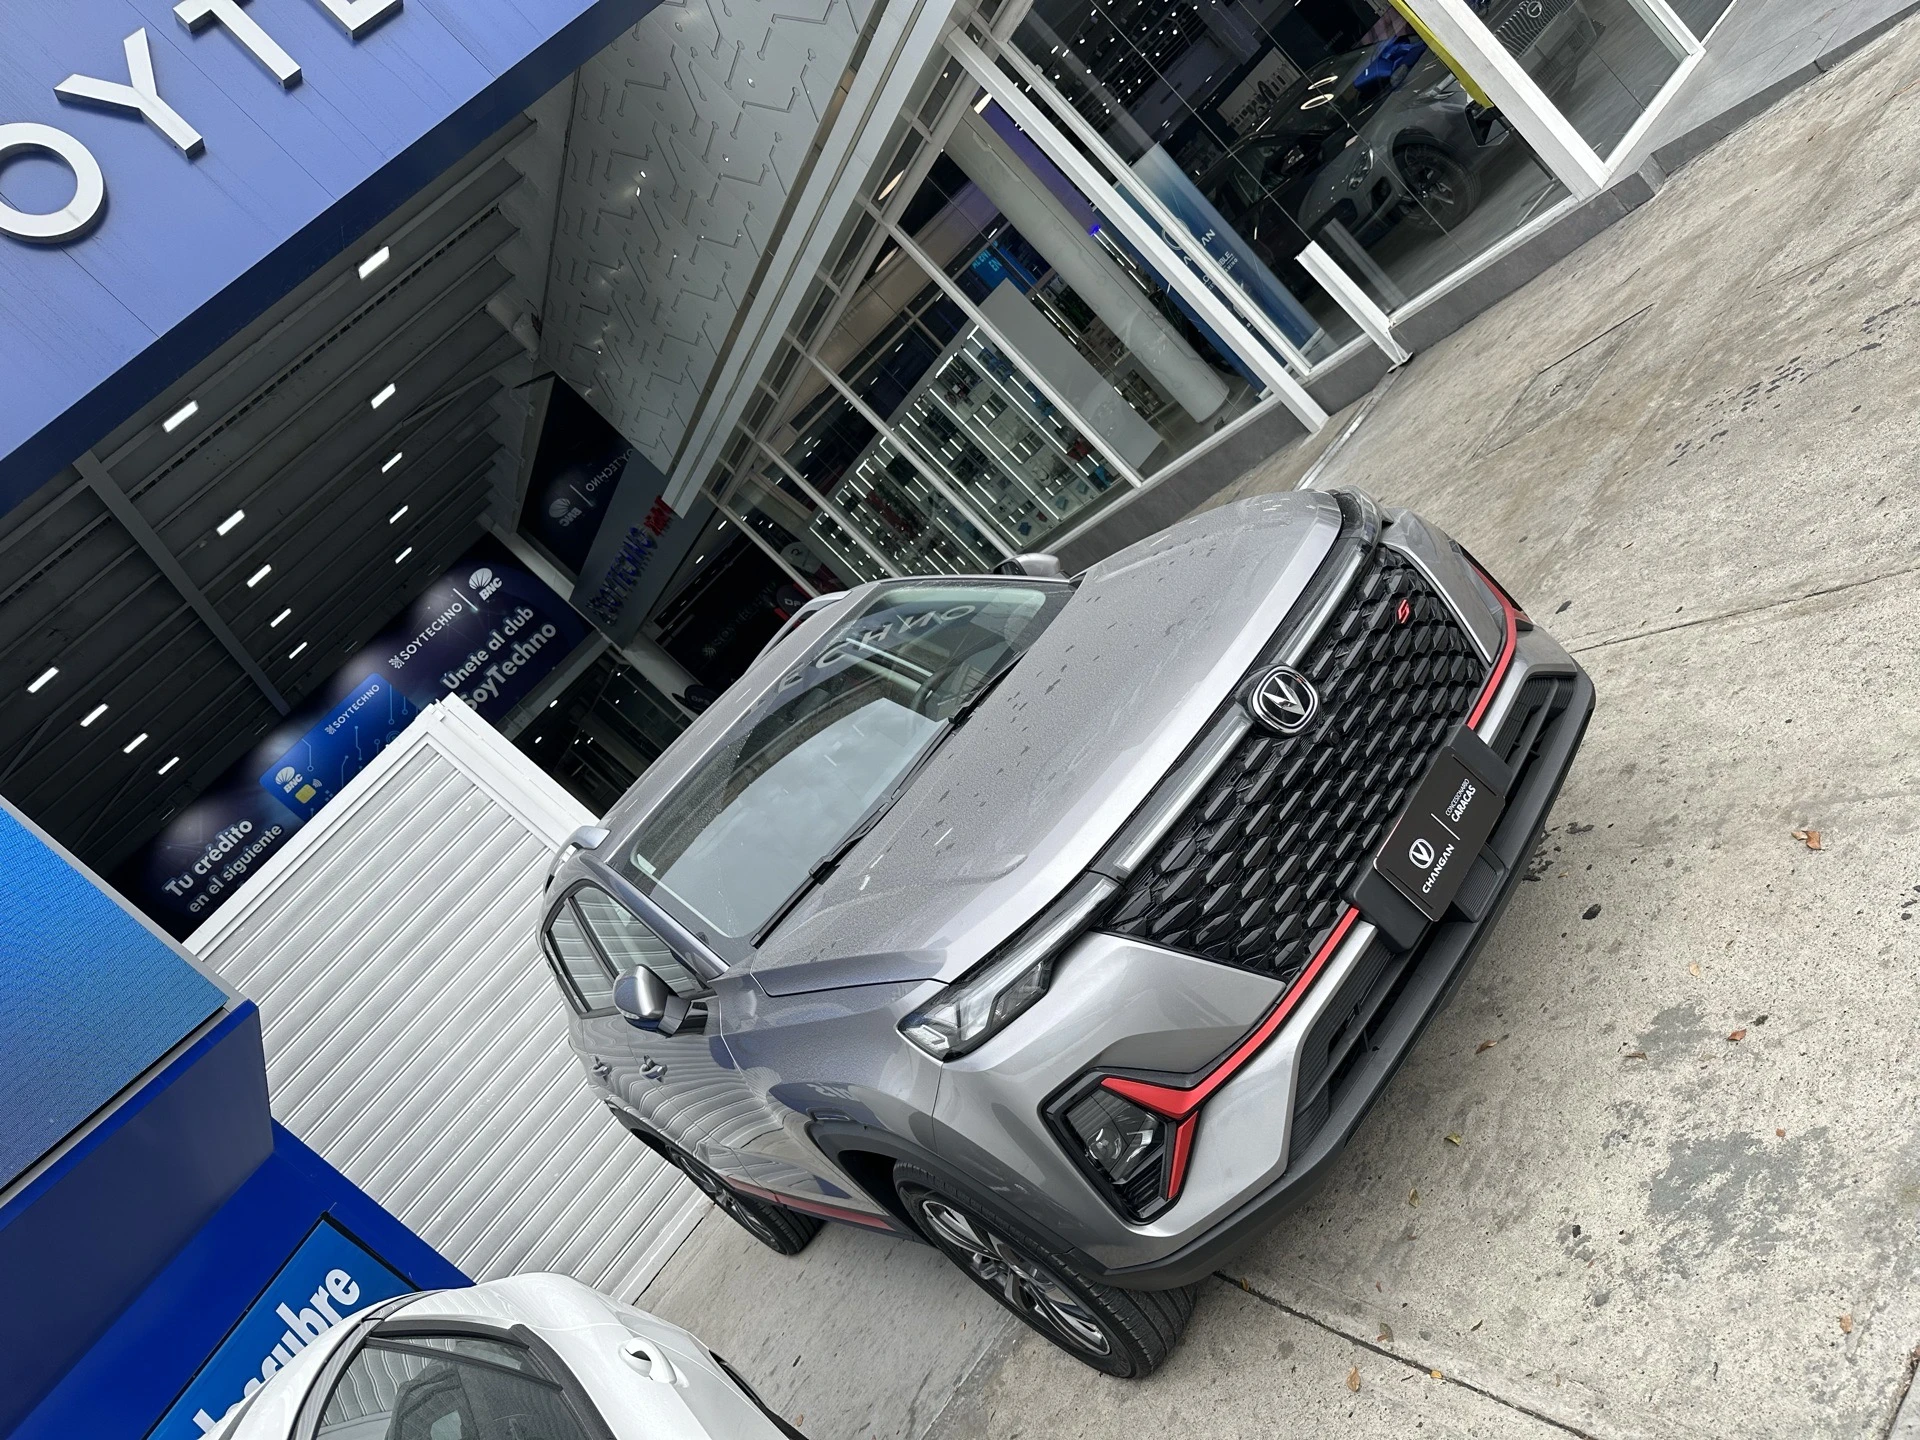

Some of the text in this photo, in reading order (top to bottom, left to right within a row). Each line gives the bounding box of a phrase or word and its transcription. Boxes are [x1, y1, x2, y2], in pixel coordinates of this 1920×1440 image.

[0, 0, 404, 243] OYT
[478, 577, 503, 601] BNC
[400, 602, 463, 661] SOYTECHNO
[442, 608, 534, 690] Únete al club
[332, 684, 380, 729] SOYTECHNO
[283, 773, 303, 794] BNC
[1445, 778, 1470, 816] CONCESIONARIO
[1451, 784, 1476, 823] CARACAS
[165, 820, 253, 897] Tu crédito
[189, 825, 282, 913] en el siguiente
[1422, 843, 1455, 894] CHANGAN
